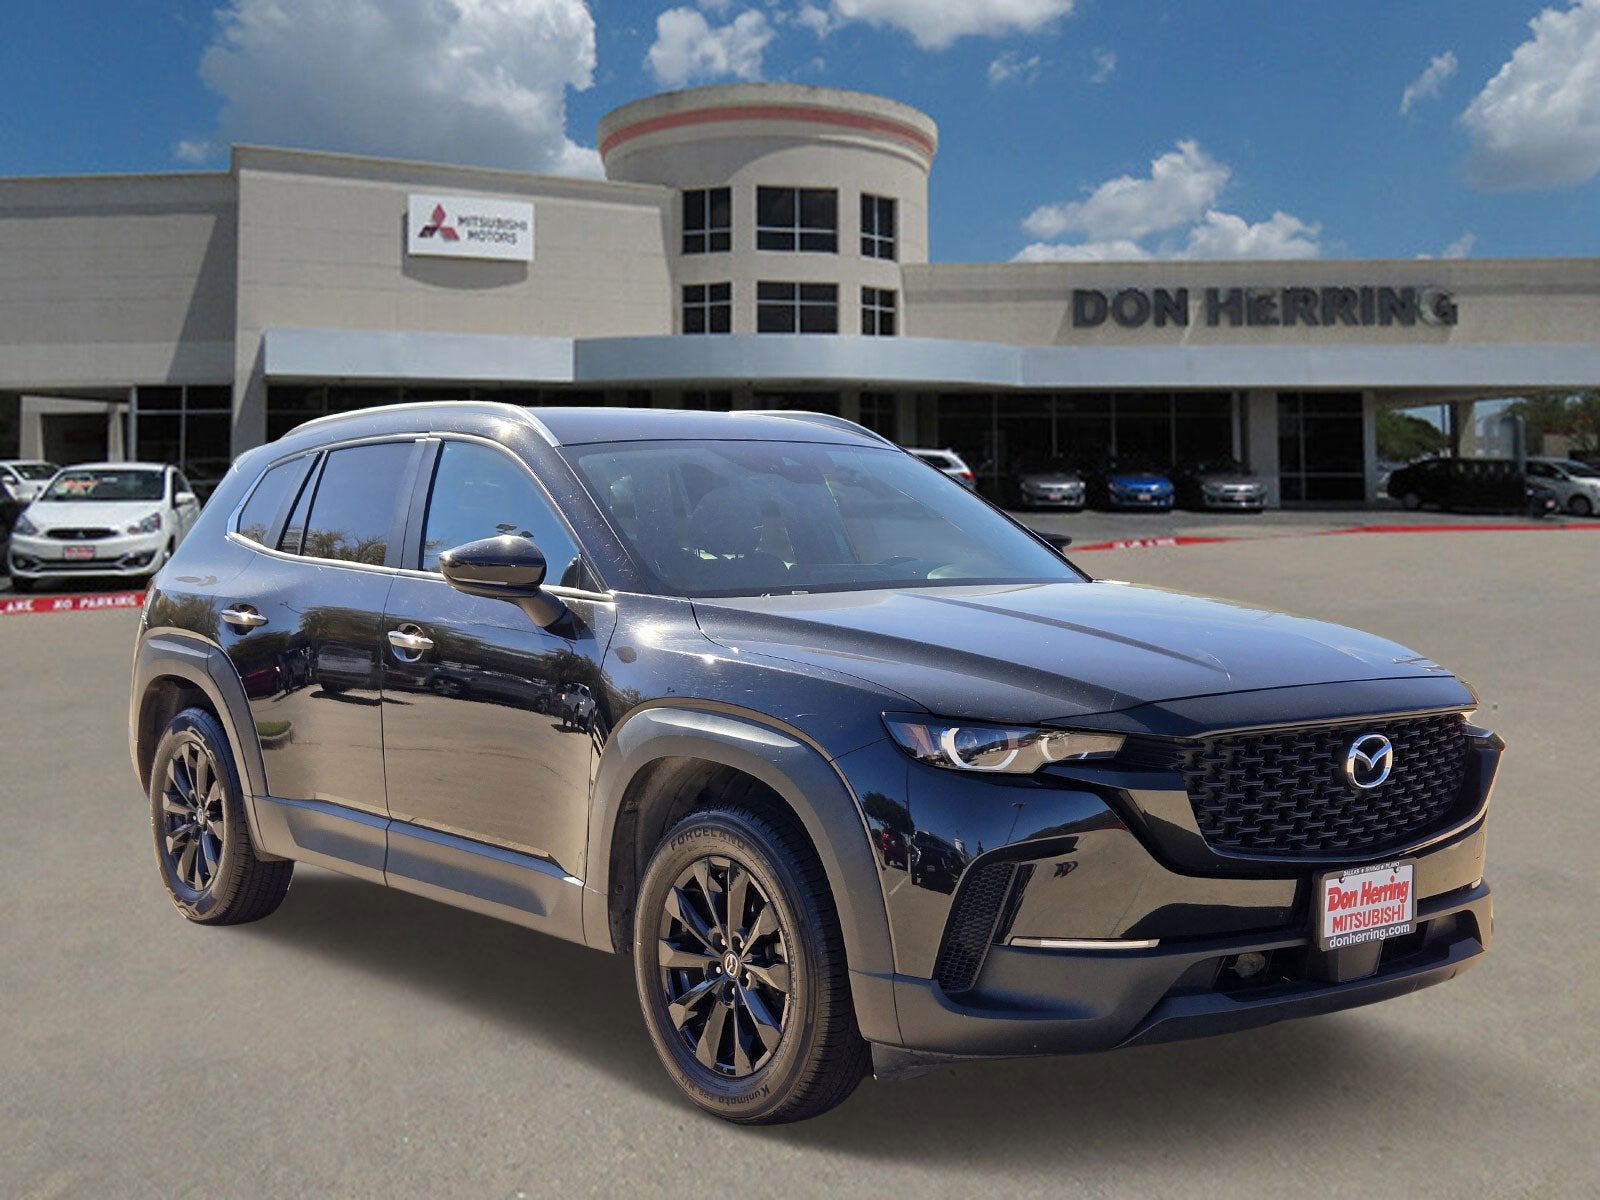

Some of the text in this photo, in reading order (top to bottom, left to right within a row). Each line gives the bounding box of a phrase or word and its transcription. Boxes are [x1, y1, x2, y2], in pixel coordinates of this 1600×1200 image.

[457, 216, 528, 231] MITSUBISHI
[467, 230, 517, 245] MOTORS
[1072, 285, 1460, 328] DON HERRING
[670, 826, 746, 851] FORCELAND
[1327, 874, 1410, 912] Don Herring
[1332, 902, 1405, 934] MITSUBISHI
[1329, 923, 1410, 948] donherring.com
